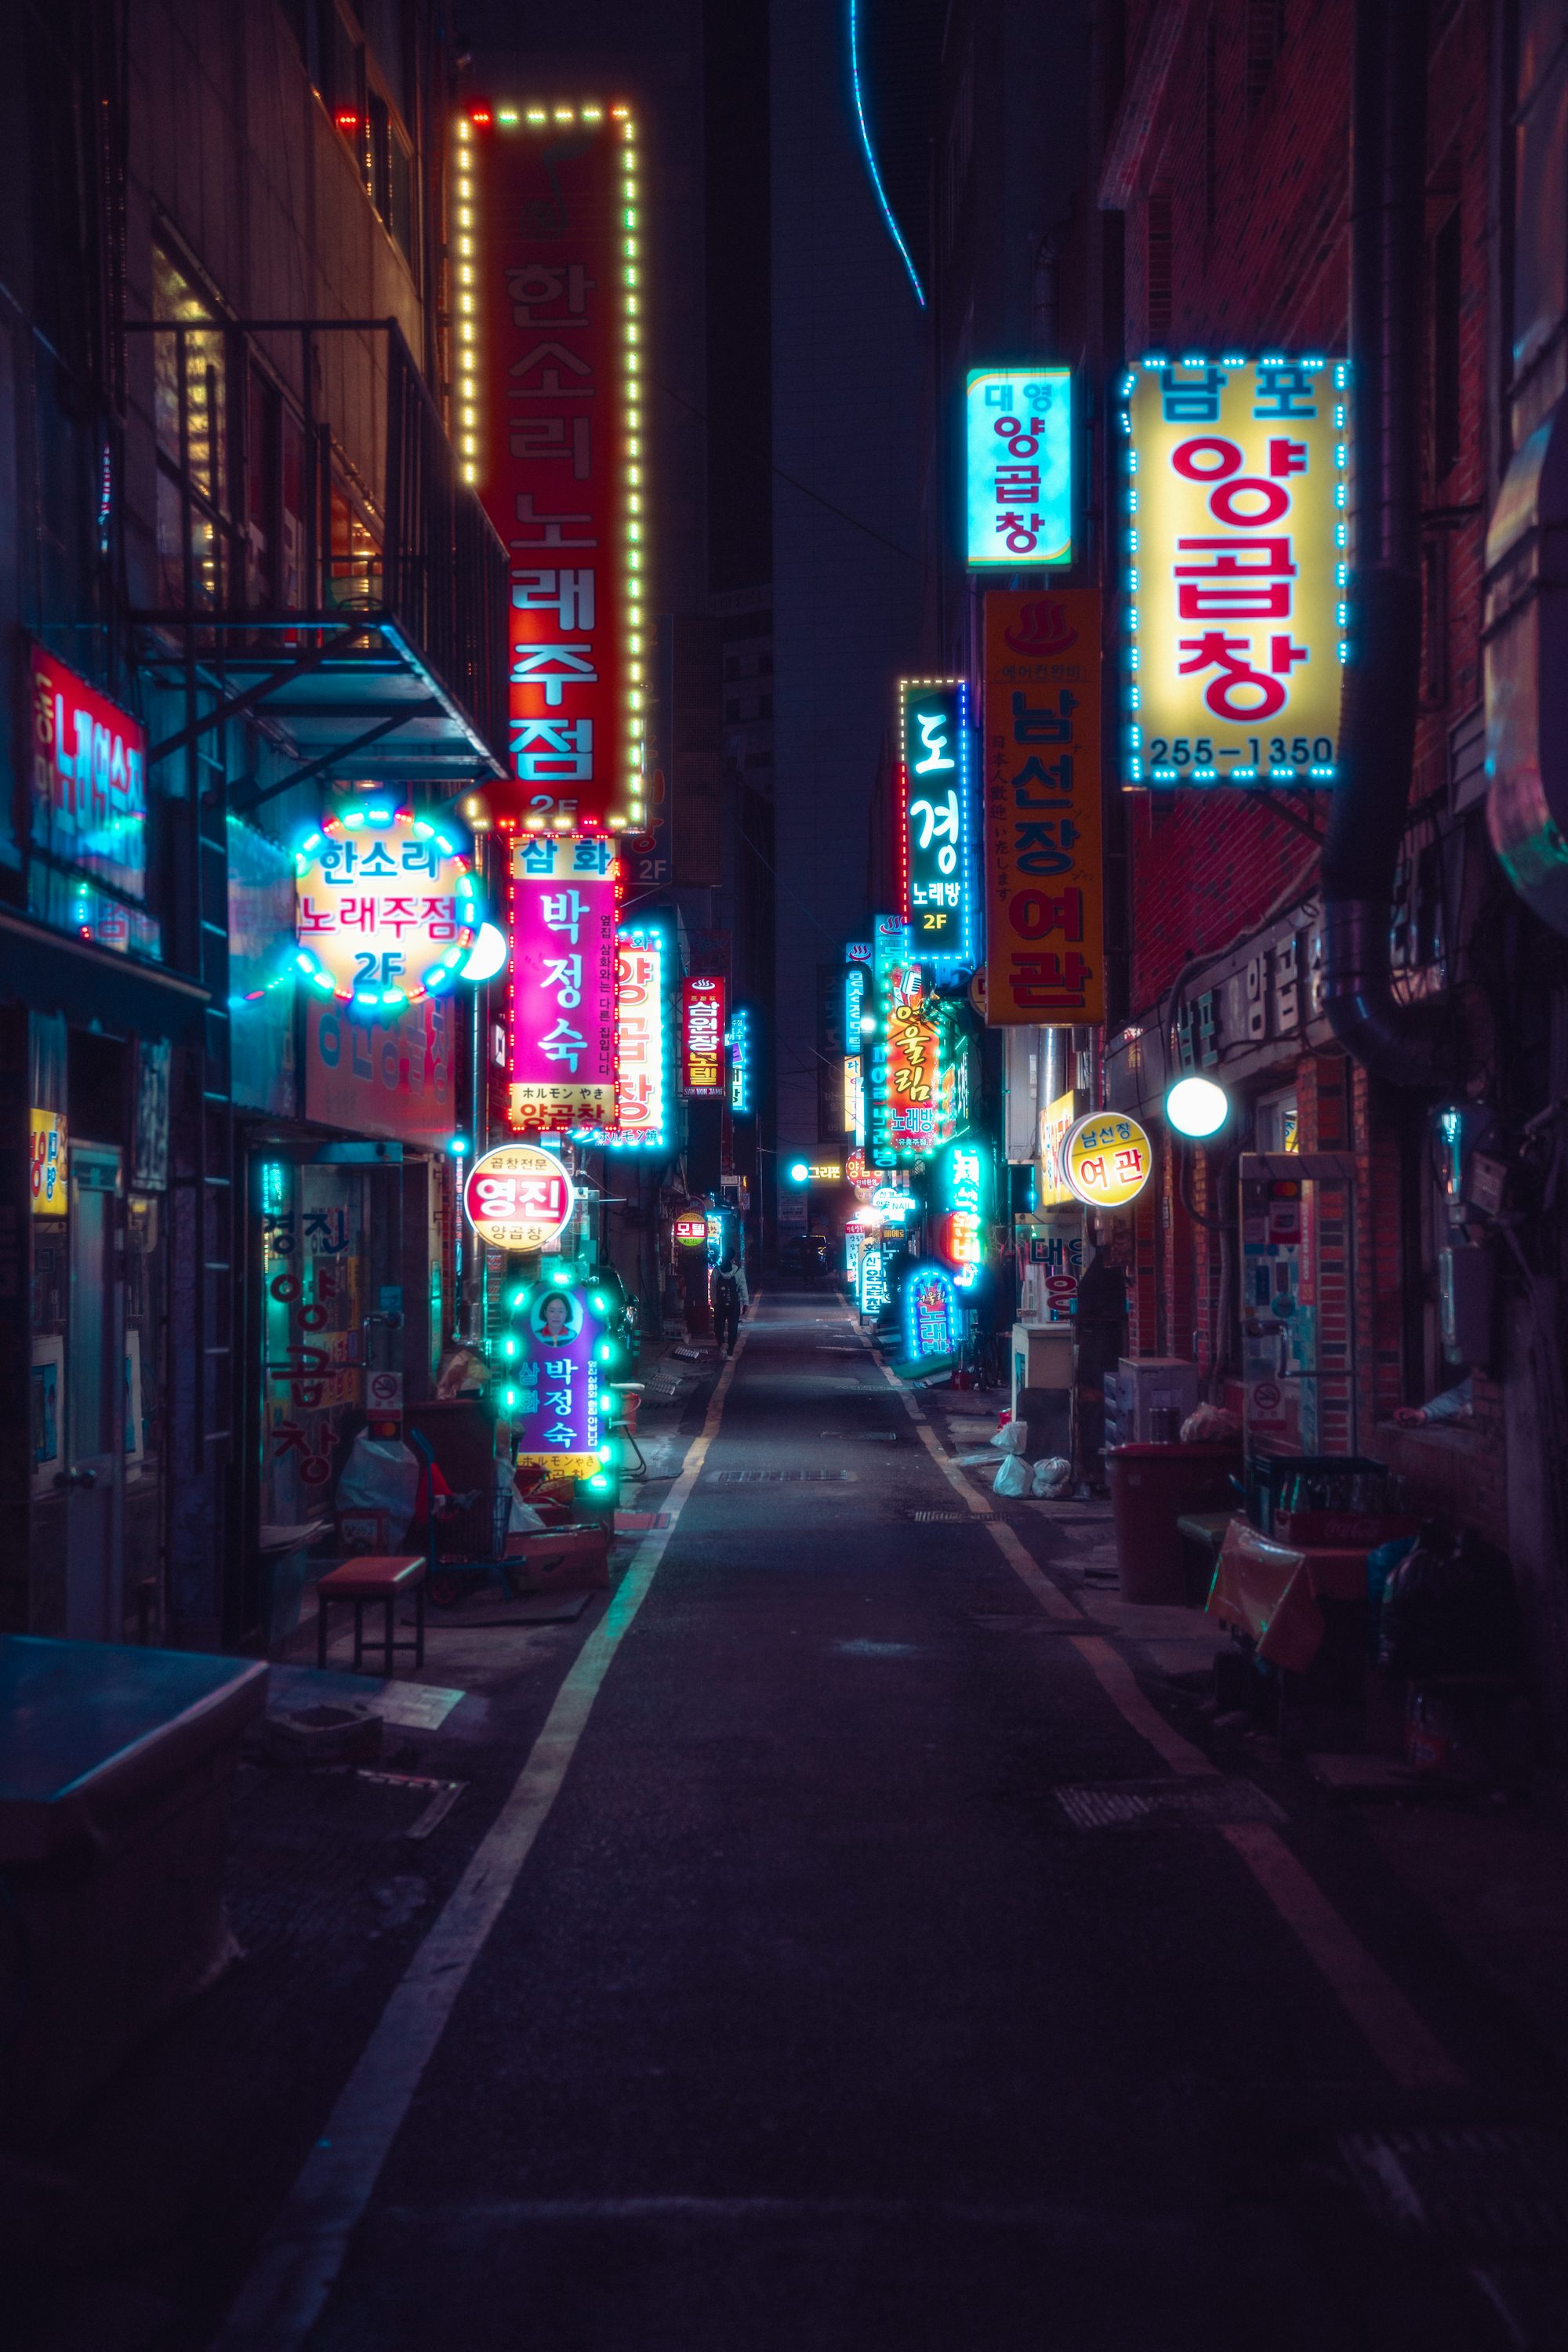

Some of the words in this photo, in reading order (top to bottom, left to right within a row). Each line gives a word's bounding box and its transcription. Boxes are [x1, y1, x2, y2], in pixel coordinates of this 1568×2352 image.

[504, 263, 597, 480] 한소리
[985, 383, 1053, 412] 대영
[1159, 366, 1316, 422] 남포
[994, 416, 1046, 554] 양곱창
[1171, 436, 1309, 721] 양곱창
[509, 492, 598, 781] 노래주점
[1011, 688, 1080, 877] 남선장
[528, 794, 579, 818] 2F
[319, 839, 440, 884] 한소리
[521, 838, 612, 875] 삼화
[639, 860, 667, 880] 2F
[913, 882, 960, 907] 노래방
[297, 896, 456, 941] 노래주점
[924, 914, 947, 930] 2F
[354, 953, 404, 986] 2F
[1008, 887, 1091, 1010] 여관
[538, 889, 590, 1074] 박정숙
[618, 956, 653, 1121] 양곱창
[688, 1001, 720, 1051] 삼원장
[687, 1051, 719, 1086] 모텔
[895, 1005, 932, 1102] 어울림
[523, 1087, 574, 1099] ホルモン
[580, 1087, 604, 1100] やき
[521, 1103, 605, 1127] 양곱창
[891, 1108, 933, 1133] 노래방
[1082, 1122, 1131, 1149] 남선장
[898, 1138, 927, 1146] 유흥주점
[491, 1157, 547, 1171] 곱창전문
[1080, 1148, 1145, 1192] 여관
[476, 1178, 561, 1218] 영진
[492, 1225, 543, 1240] 양곱창
[677, 1222, 705, 1236] 모텔
[270, 1269, 339, 1487] 양곱창
[519, 1362, 541, 1414] 삼화
[543, 1358, 579, 1449] 박정숙
